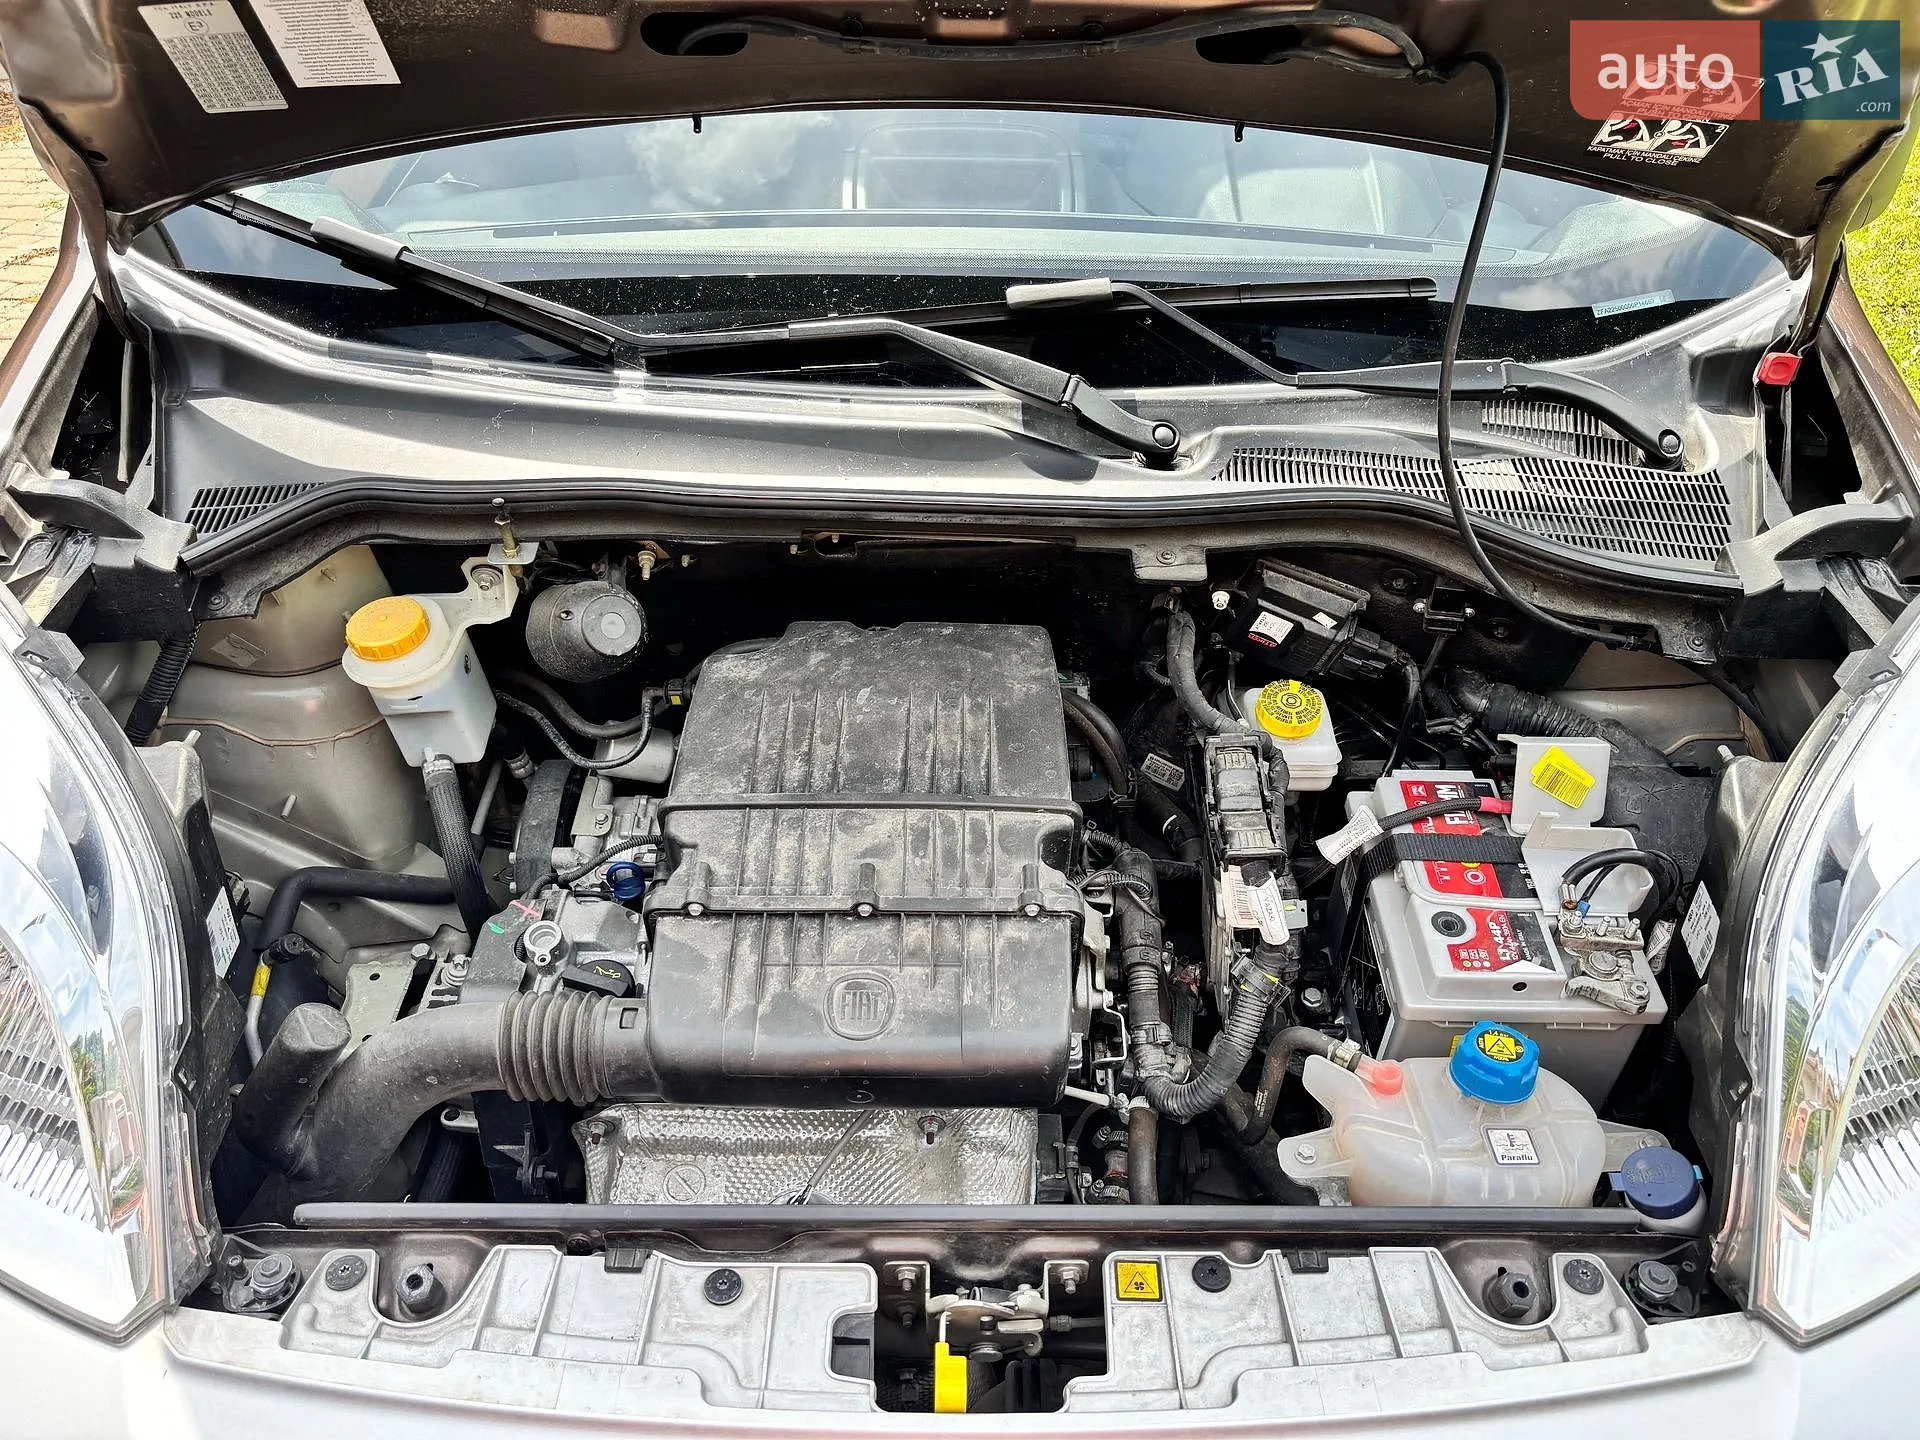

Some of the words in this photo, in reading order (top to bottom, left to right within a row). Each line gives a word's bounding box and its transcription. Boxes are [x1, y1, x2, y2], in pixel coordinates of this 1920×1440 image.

[1637, 109, 1666, 118] PUSH
[1682, 113, 1712, 122] OPEN
[1587, 145, 1626, 156] KAPATMAK
[1603, 153, 1628, 161] PULL
[1645, 157, 1681, 167] CLOSE
[840, 989, 882, 1021] FIAT
[1501, 1153, 1534, 1163] Paraflu
